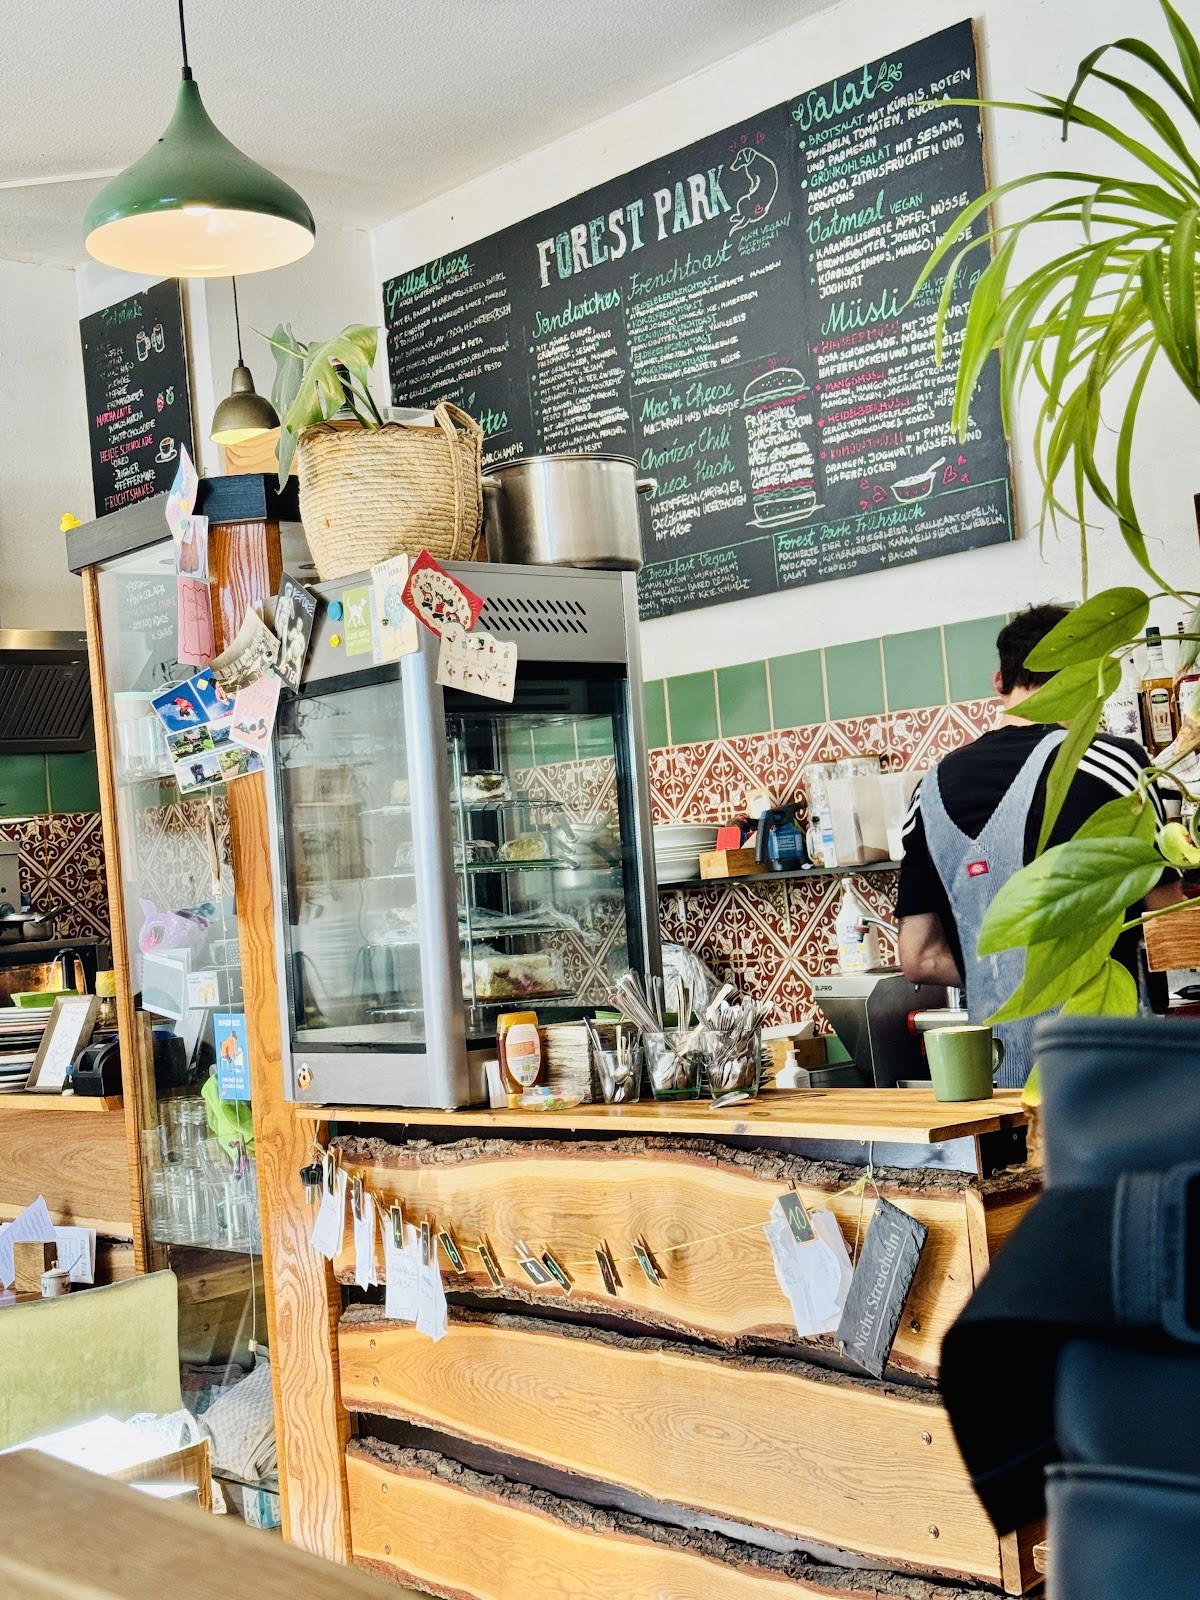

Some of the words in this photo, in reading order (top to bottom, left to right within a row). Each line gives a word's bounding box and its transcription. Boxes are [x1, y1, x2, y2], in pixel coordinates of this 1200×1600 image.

[798, 64, 878, 131] Salat
[809, 113, 865, 146] BROTSALAT
[867, 109, 884, 124] MIT
[930, 67, 971, 94] ROTEN
[807, 157, 825, 174] UND
[828, 137, 877, 169] PARMESAN
[811, 144, 892, 187] GRÜNKOHLSALAT
[895, 137, 913, 155] MIT
[917, 117, 962, 144] SESAM,
[851, 143, 939, 186] ZITRUSFRÜCHTEN
[941, 133, 965, 151] UND
[808, 189, 855, 215] CROUTONS
[536, 198, 645, 289] FOREST
[653, 164, 732, 241] PARK
[806, 189, 885, 244] Oatmeal
[890, 192, 923, 215] VEGAN
[816, 221, 893, 259] KARAMELLISIERTE
[891, 220, 936, 245] JOGHURT
[627, 239, 733, 301] Frenchtoast
[386, 265, 430, 320] Grilled
[431, 254, 469, 284] Cheese
[819, 275, 864, 299] JOGHURT
[532, 288, 621, 338] Sandwiches
[821, 288, 901, 335] Müsli
[902, 320, 918, 333] MIT
[817, 353, 839, 366] ROSA
[818, 353, 888, 379] HAFERFLOCKEN
[889, 346, 908, 359] UND
[888, 365, 903, 376] MIT
[639, 397, 669, 422] Mac
[686, 382, 735, 408] Cheese
[887, 380, 922, 400] JOGHURT
[916, 391, 933, 402] MIT
[906, 410, 936, 426] KOKOS
[699, 424, 731, 452] Chili
[905, 430, 921, 443] MIT
[916, 434, 957, 455] NÜSSEN
[694, 454, 735, 482] Hash
[827, 461, 897, 486] HAFERFLOCKEN
[104, 481, 155, 510] FRUCHTSHAKES
[777, 528, 816, 551] Forest
[820, 521, 851, 540] Park
[855, 502, 926, 533] Frühstück
[888, 525, 960, 548] KARAMELLISIERTE
[647, 558, 695, 581] Breakfast
[698, 549, 738, 571] Vegan
[778, 546, 820, 562] POCHIERTE
[822, 540, 841, 552] EIER
[783, 569, 807, 582] SALAT
[789, 1205, 807, 1232] 10
[853, 1309, 876, 1353] Nicht
[866, 1238, 901, 1311] Streicheln
